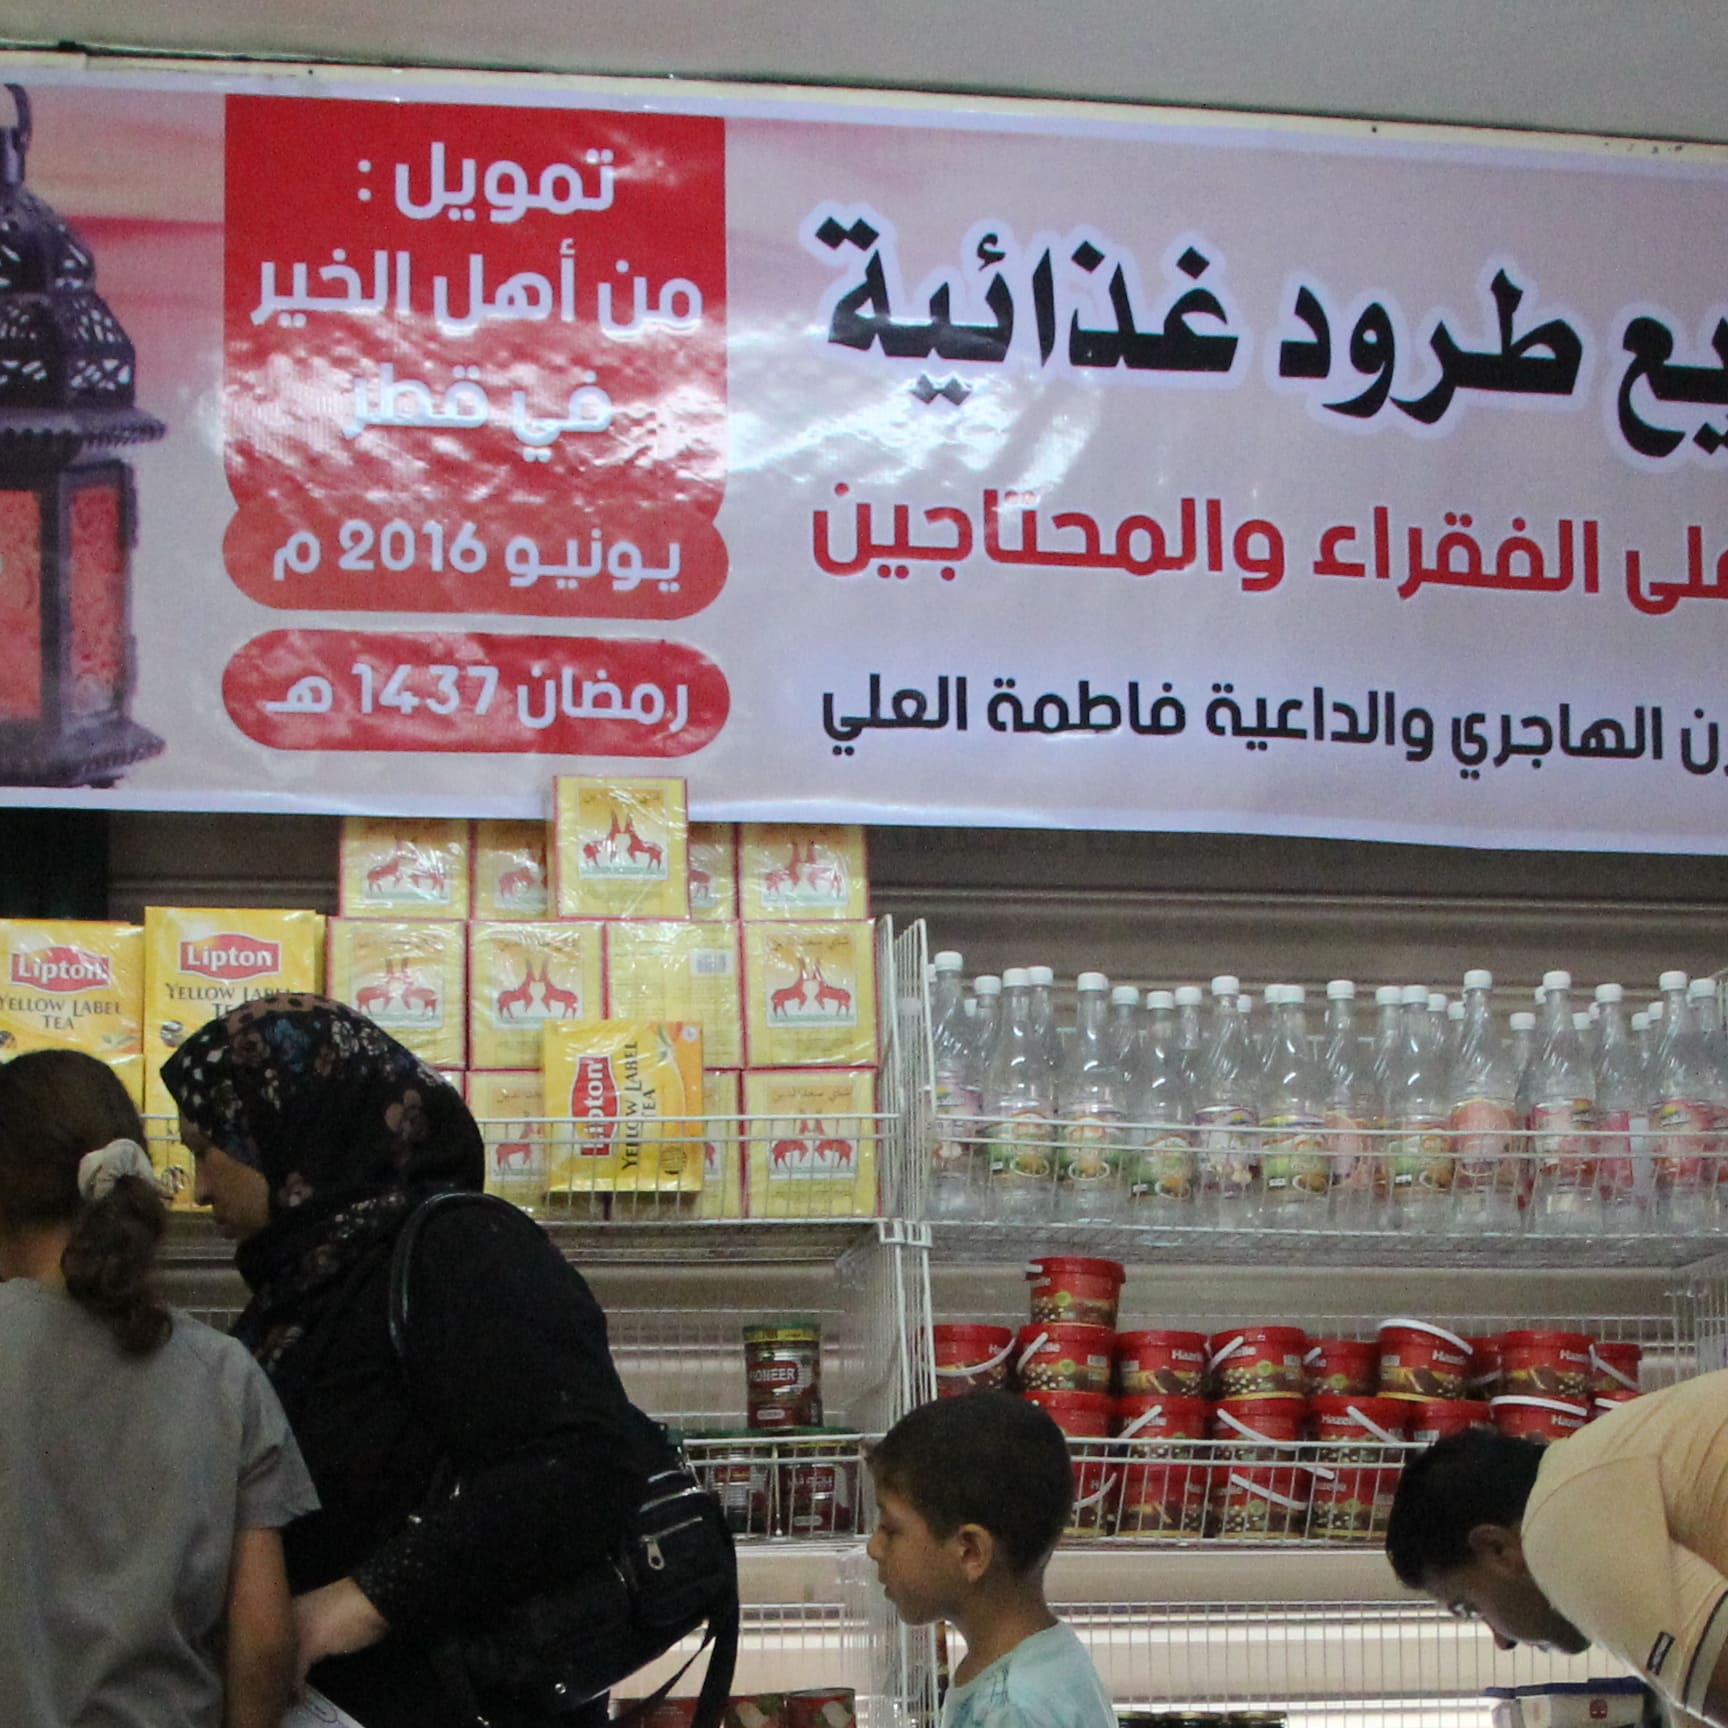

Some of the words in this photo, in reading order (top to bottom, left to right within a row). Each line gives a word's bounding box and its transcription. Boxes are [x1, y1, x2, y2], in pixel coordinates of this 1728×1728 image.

[394, 141, 615, 223] تمويل
[250, 248, 410, 327] الخير
[433, 238, 575, 337] أهل
[597, 260, 702, 341] من
[815, 215, 1240, 405] غذائية
[1278, 269, 1584, 424] طرود
[343, 362, 488, 439] قطر
[512, 370, 612, 463] في
[273, 536, 321, 581] م
[339, 519, 488, 572] 2016
[507, 528, 679, 593] يونيو
[811, 480, 1286, 592] والمحتاجين
[1312, 504, 1600, 601] الفقراء
[352, 662, 499, 715] 1437
[515, 669, 690, 732] رمضان
[821, 672, 968, 757] العلي
[987, 676, 1186, 737] فاطمة
[1206, 680, 1434, 763] والداعية
[1450, 704, 1662, 781] الهاجري
[18, 955, 109, 984] Lipton
[165, 982, 235, 1001] YELLOW
[186, 943, 273, 968] Lipton
[43, 1014, 75, 1031] TEA
[72, 997, 121, 1019] LABEL
[625, 1040, 643, 1093] LABEL
[580, 1061, 606, 1157] Lipton
